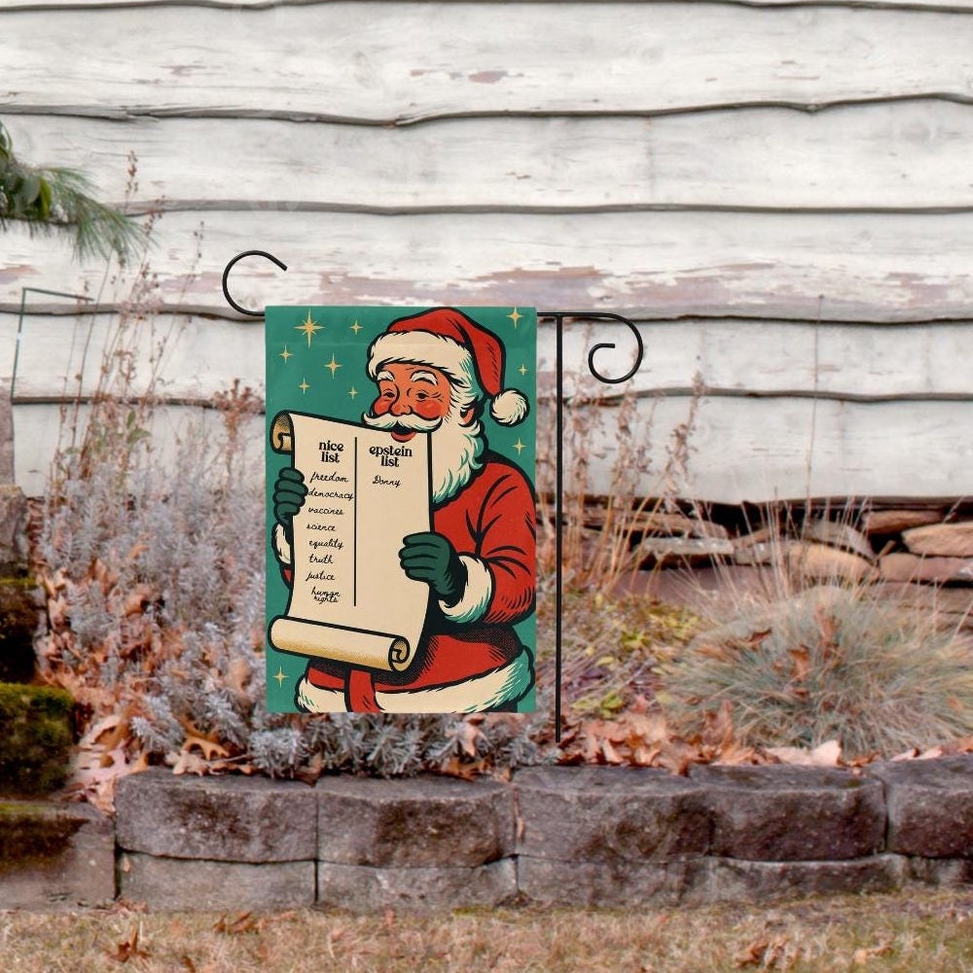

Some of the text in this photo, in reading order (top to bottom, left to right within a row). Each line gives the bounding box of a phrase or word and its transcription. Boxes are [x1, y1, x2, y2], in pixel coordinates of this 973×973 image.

[319, 440, 344, 451] nice
[368, 445, 413, 457] epstein
[321, 451, 340, 463] list
[381, 456, 400, 467] list
[309, 471, 349, 483] freedom
[308, 488, 353, 501] democracy
[308, 507, 344, 515] vaccines
[306, 523, 336, 531] science
[309, 539, 344, 550] equality
[309, 553, 333, 564] truth
[305, 571, 335, 581] justice
[311, 587, 340, 597] human
[314, 594, 338, 604] rights
